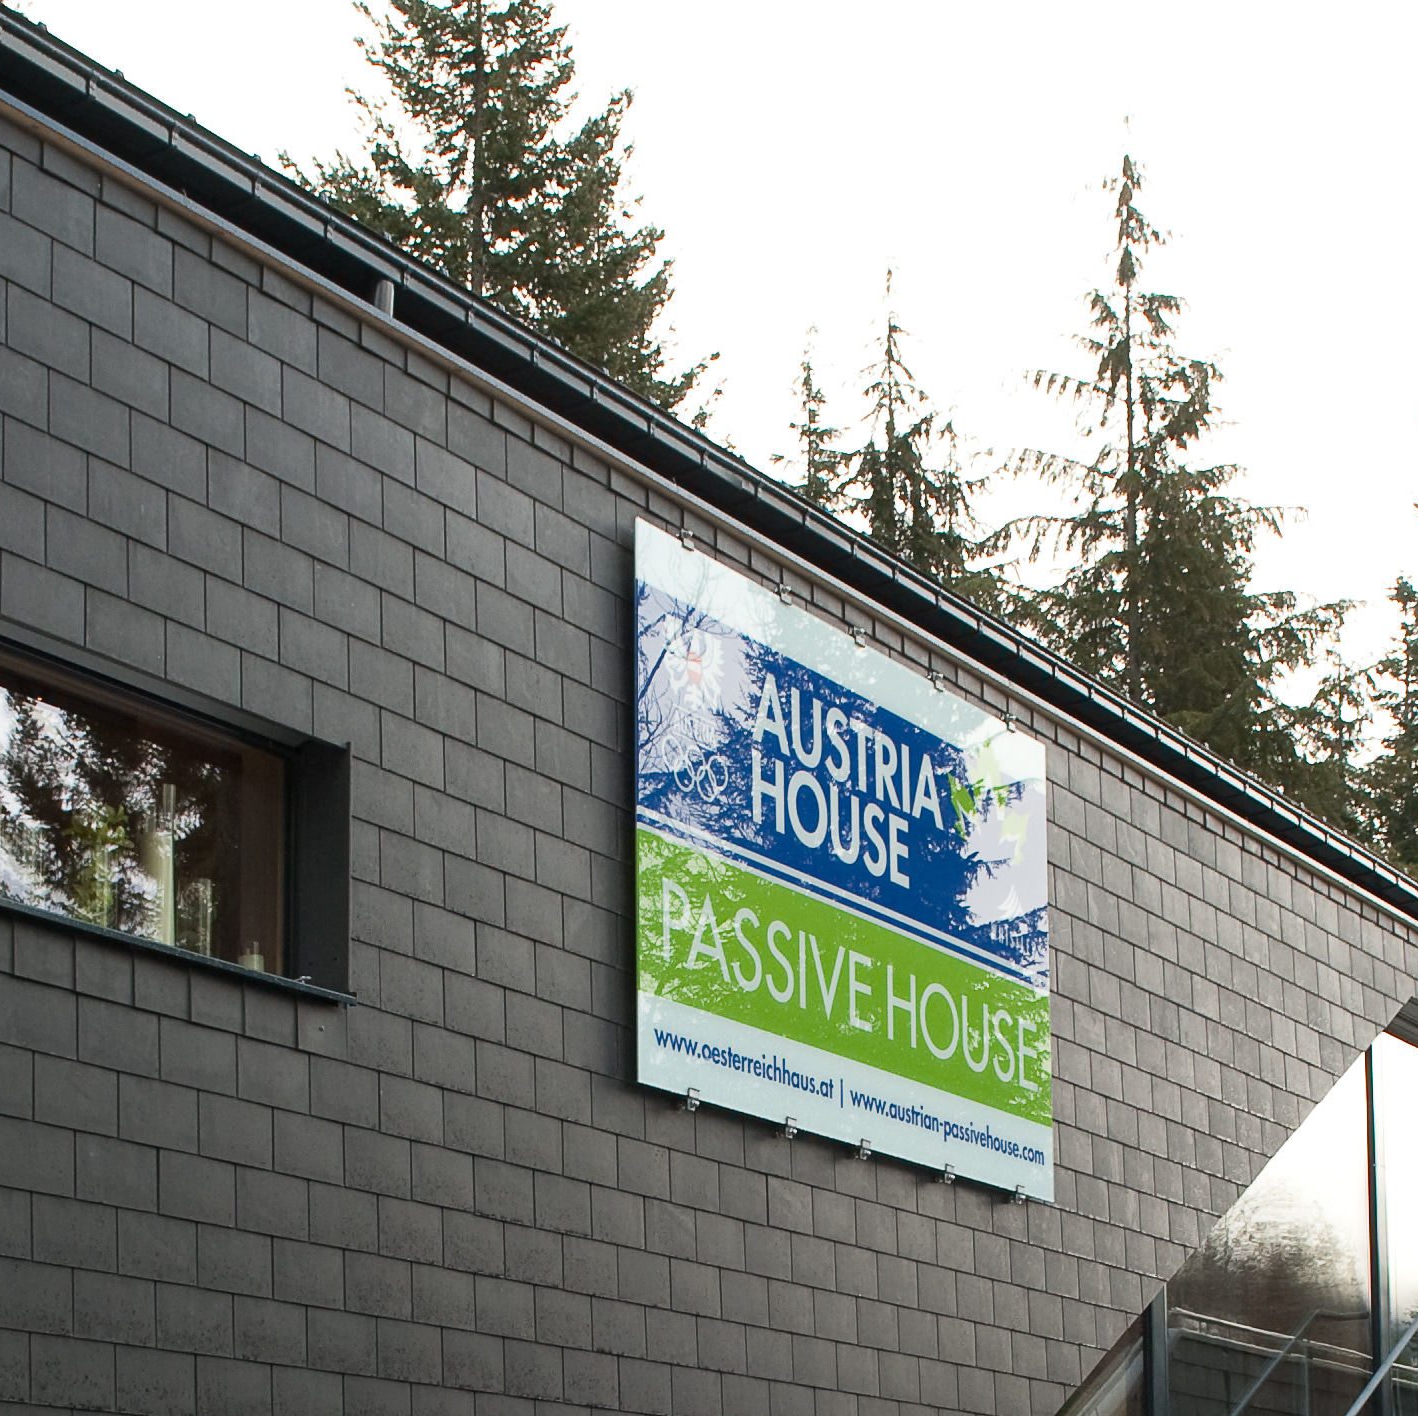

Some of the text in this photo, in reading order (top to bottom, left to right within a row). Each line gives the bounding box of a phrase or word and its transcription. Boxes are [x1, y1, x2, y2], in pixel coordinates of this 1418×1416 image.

[751, 749, 910, 889] HOUSE
[752, 672, 944, 831] AUSTRIA
[662, 877, 1039, 1092] PASSIVE HOUSE
[653, 1027, 834, 1099] www.oesterreichhaus.at
[849, 1089, 1045, 1166] www.austrian-passivehouse.com
